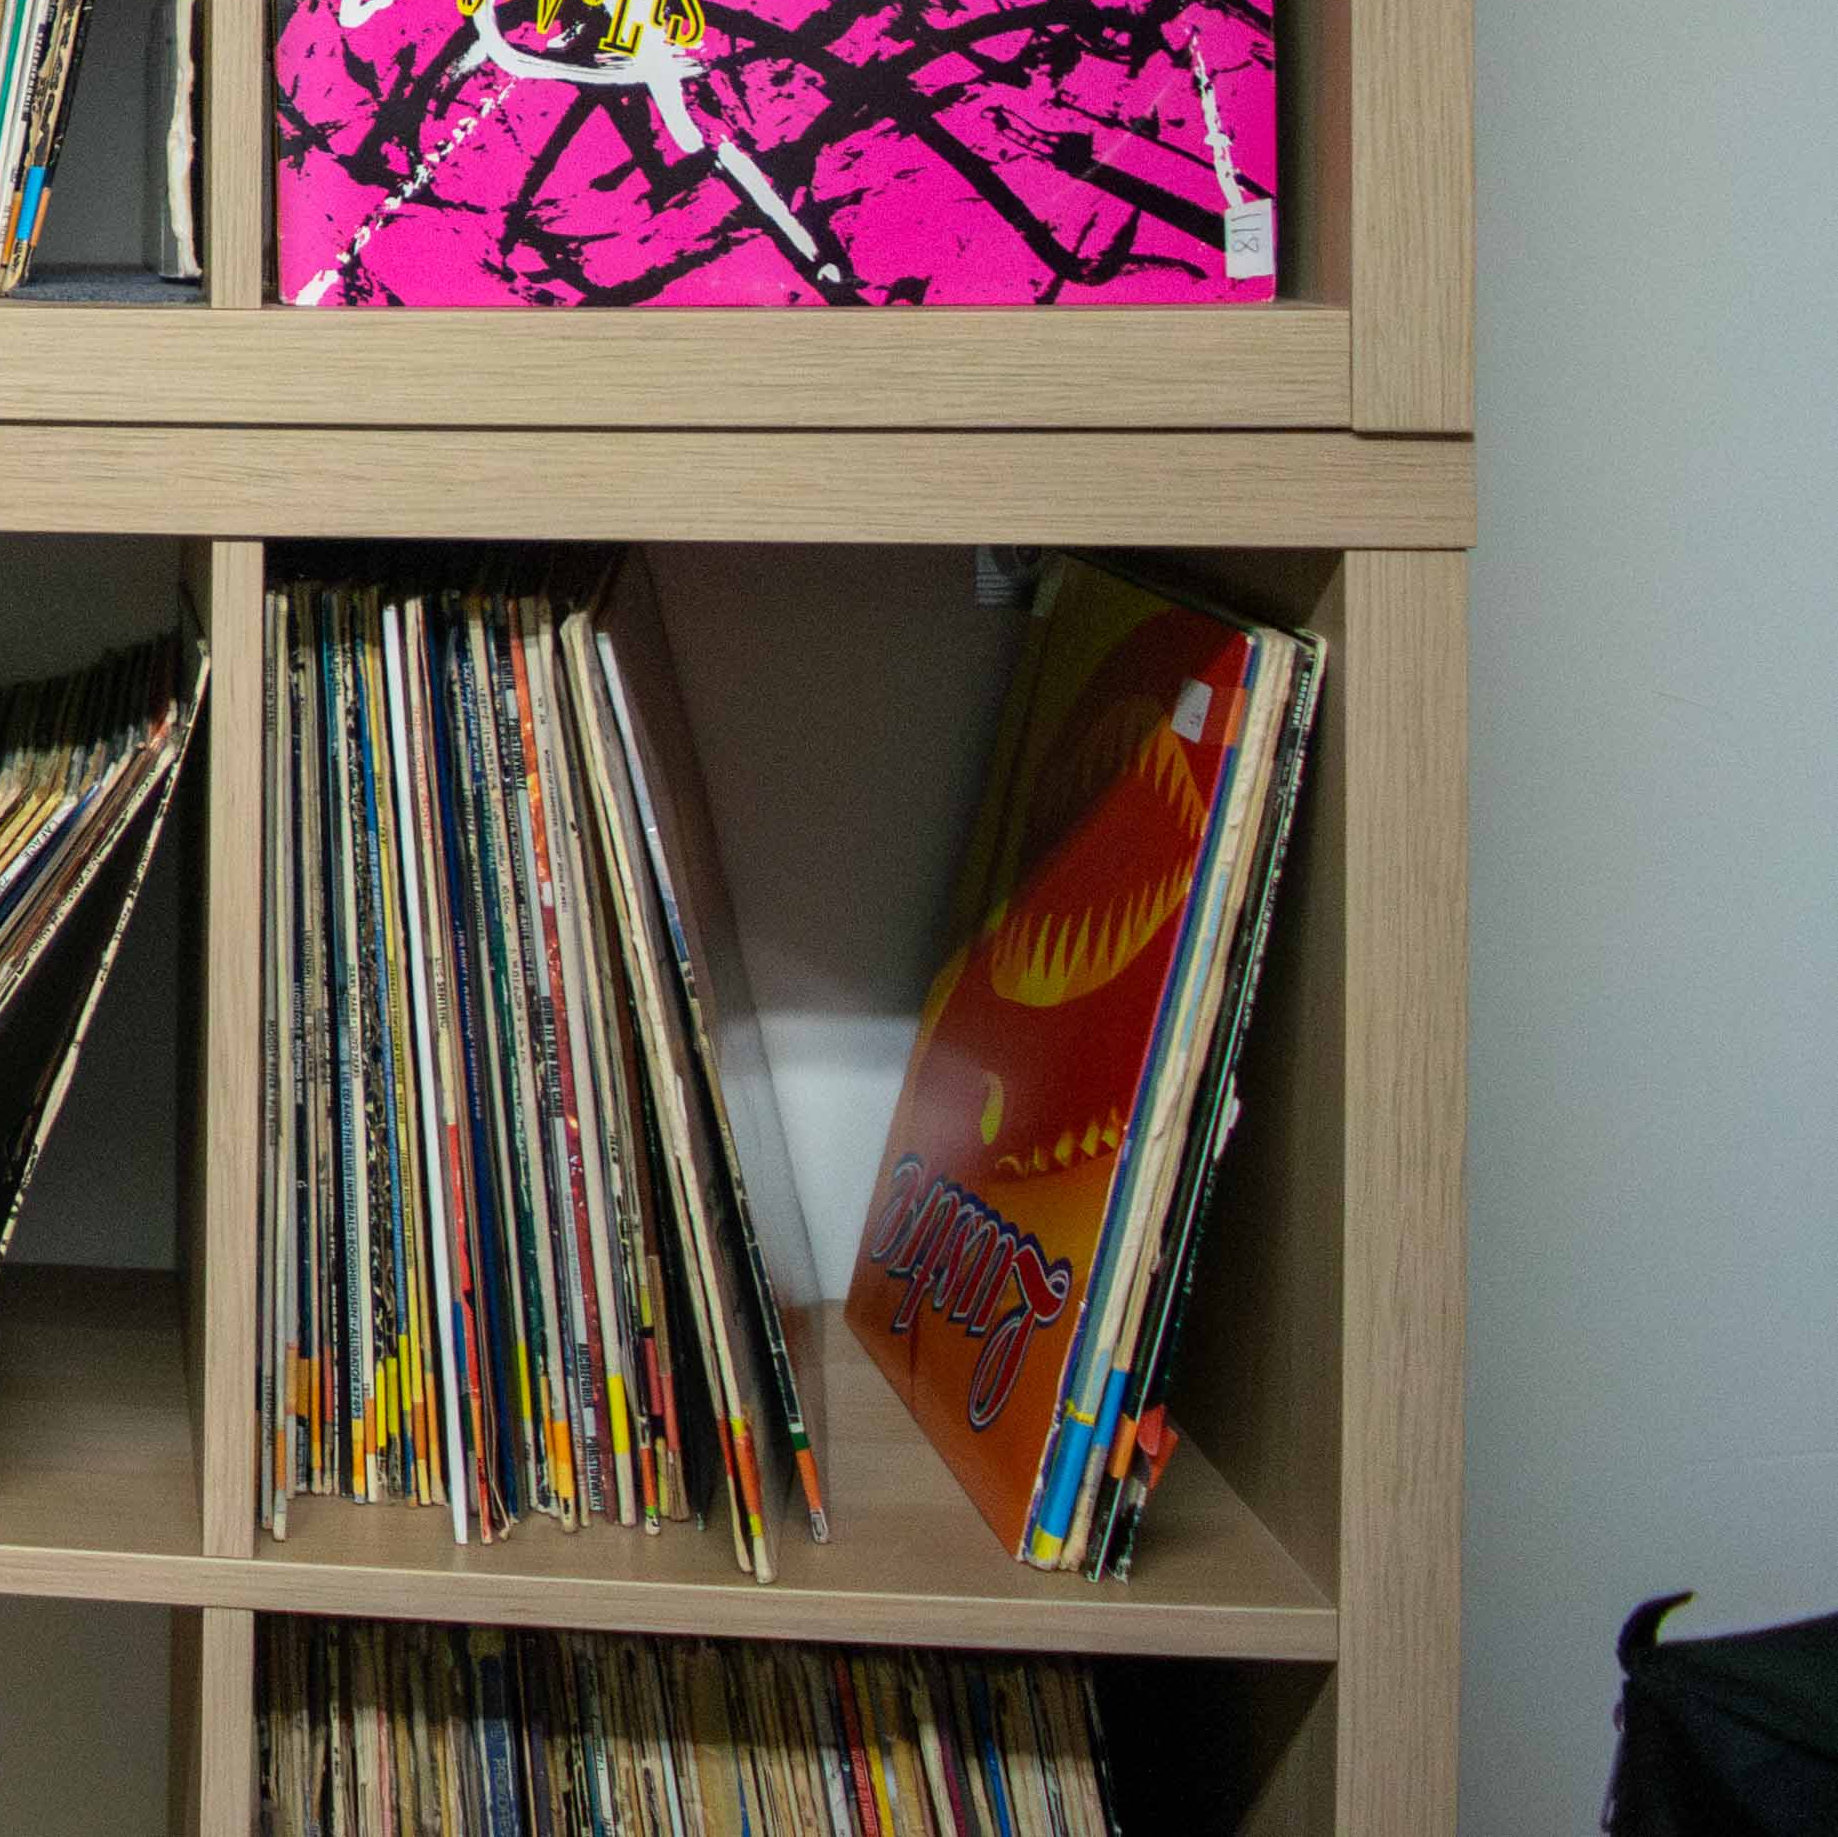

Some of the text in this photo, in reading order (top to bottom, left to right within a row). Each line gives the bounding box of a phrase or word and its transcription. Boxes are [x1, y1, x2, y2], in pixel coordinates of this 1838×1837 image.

[340, 1101, 352, 1124] AND
[340, 1126, 353, 1143] THE
[341, 1144, 354, 1177] BLUES
[342, 1179, 356, 1233] IMPERIALS
[348, 1327, 361, 1382] ALLIGATOR
